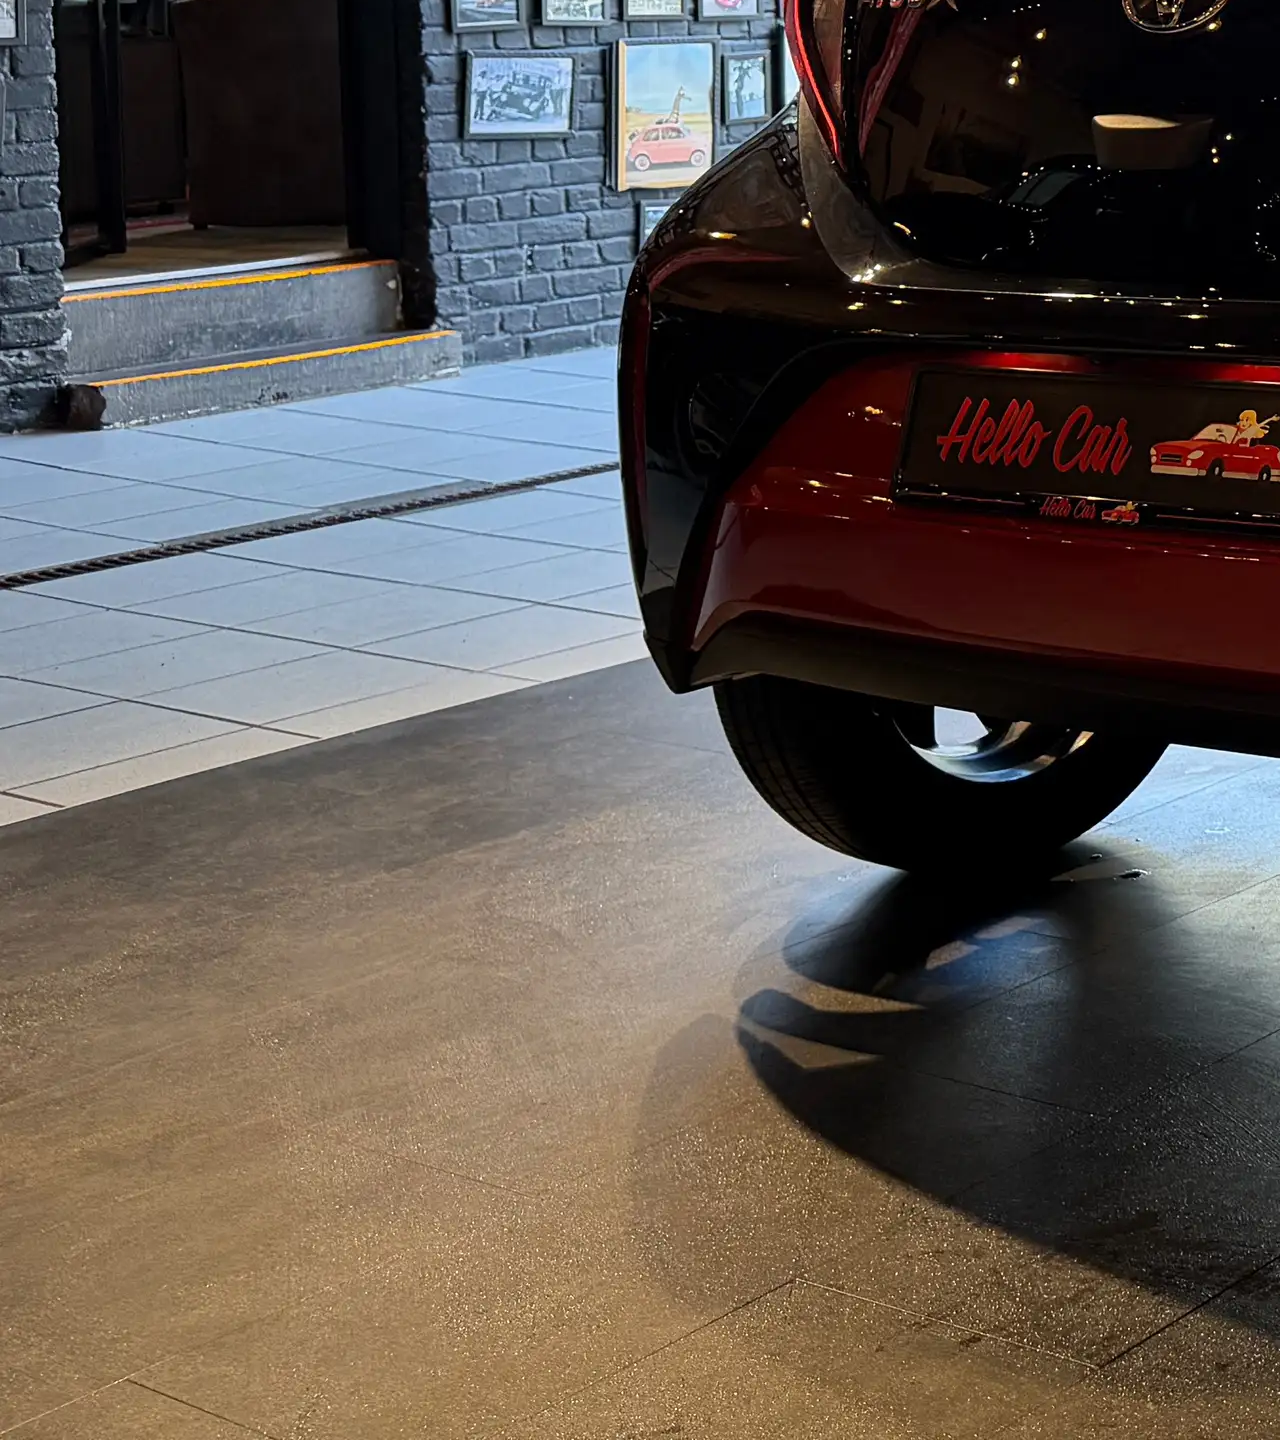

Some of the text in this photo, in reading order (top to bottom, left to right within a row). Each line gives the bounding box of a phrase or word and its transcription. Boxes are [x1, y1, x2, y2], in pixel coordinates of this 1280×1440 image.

[936, 396, 1132, 476] Hello Car
[1039, 496, 1096, 520] Hello Car
